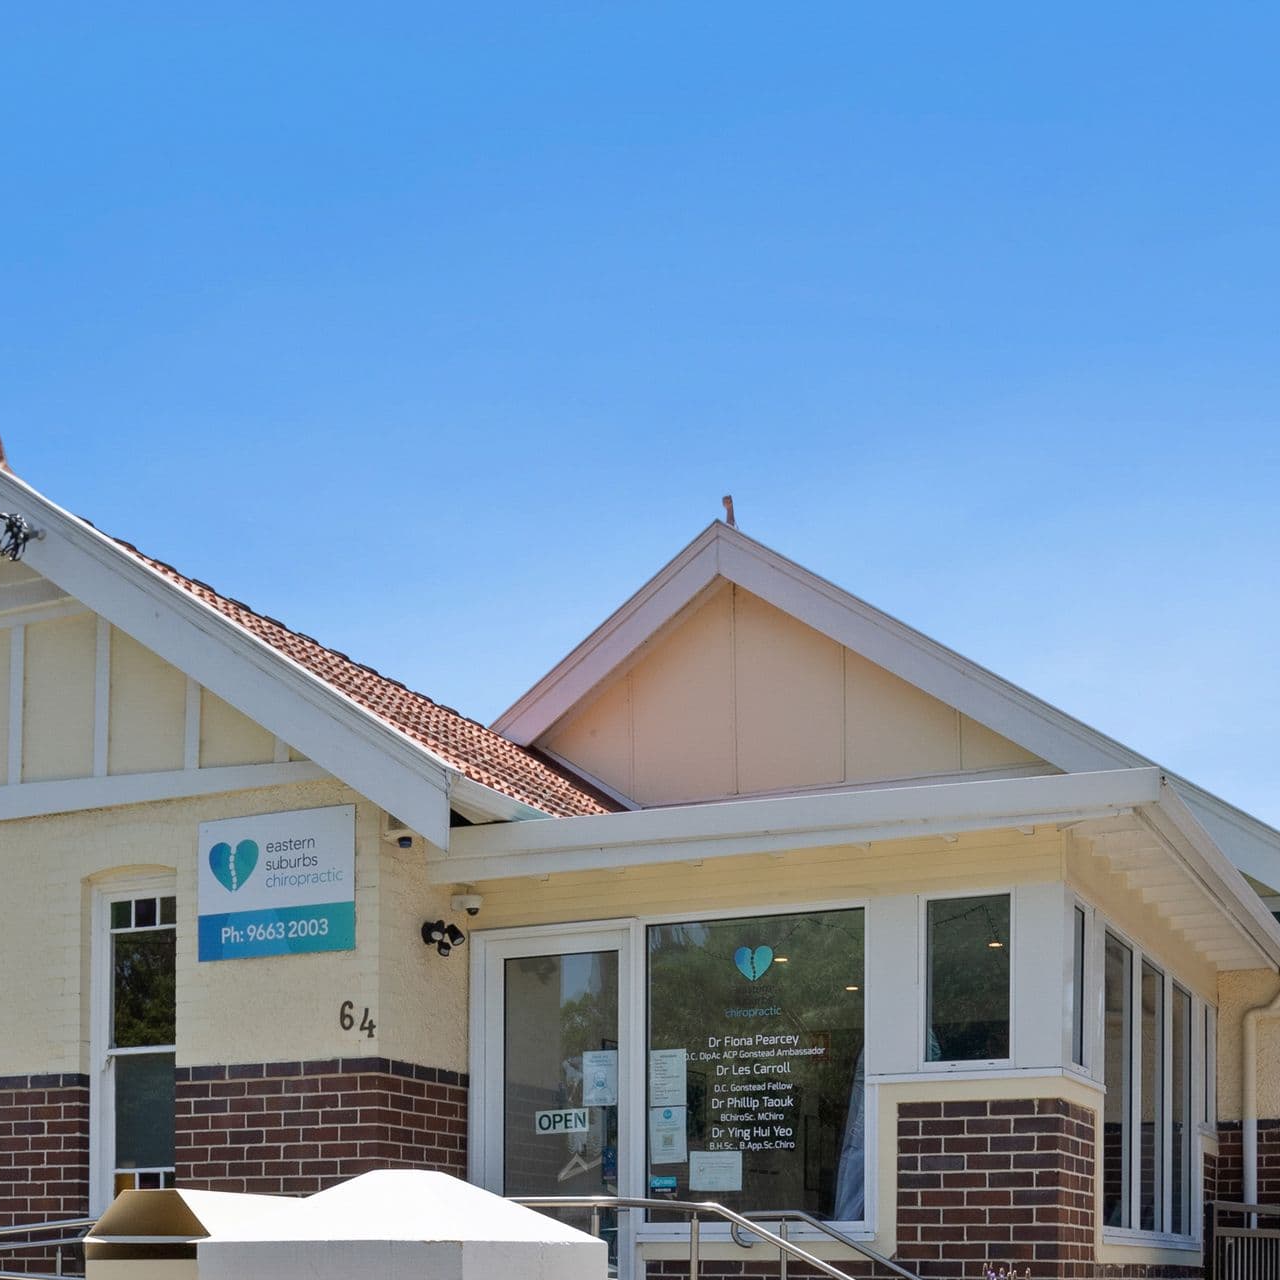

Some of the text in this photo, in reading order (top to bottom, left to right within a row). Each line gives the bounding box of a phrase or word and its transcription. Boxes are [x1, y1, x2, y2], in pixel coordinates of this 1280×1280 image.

[265, 837, 316, 853] eastern
[265, 854, 318, 872] suburbs
[265, 867, 344, 889] chiropractic
[221, 918, 329, 944] Ph: 9663 2003
[339, 1000, 377, 1038] 64
[724, 1005, 782, 1018] chiropractic
[708, 1034, 800, 1048] Dr Fiona Pearcey
[722, 1050, 738, 1059] ACP
[738, 1048, 775, 1058] Gonstead
[776, 1046, 826, 1056] Ambassador
[716, 1062, 791, 1076] Dr Les Carroll
[730, 1082, 766, 1092] Gonstead
[767, 1081, 793, 1091] Fellow
[711, 1095, 794, 1111] Dr Phillip Taouk
[538, 1111, 587, 1131] OPEN
[757, 1111, 785, 1121] MChiro
[711, 1125, 793, 1141] Dr Ying Hui Yeo
